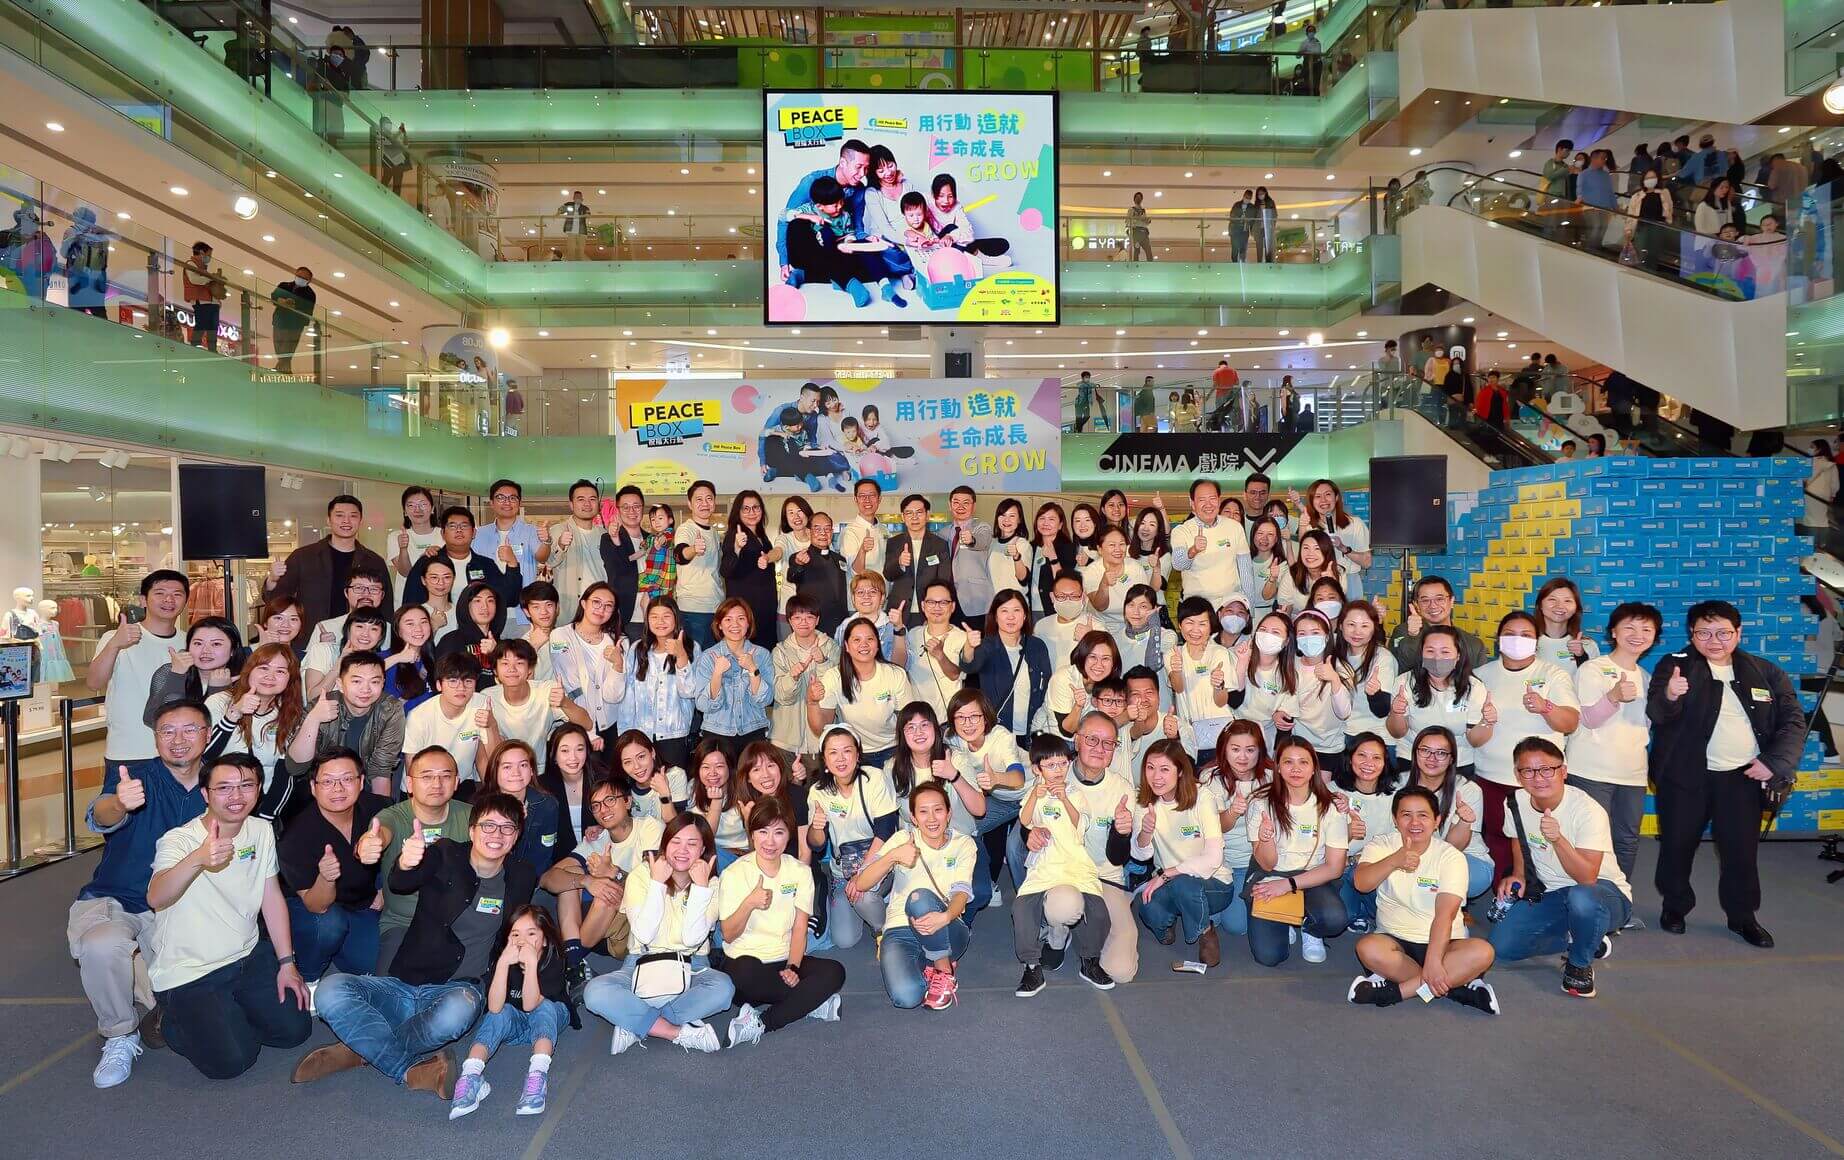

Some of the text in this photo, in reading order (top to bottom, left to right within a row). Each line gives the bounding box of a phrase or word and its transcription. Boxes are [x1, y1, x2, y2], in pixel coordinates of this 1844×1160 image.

[791, 108, 845, 125] PEACE
[919, 112, 972, 132] 用行動
[977, 112, 1020, 135] 造就
[792, 125, 827, 140] BOX
[934, 139, 1005, 158] 生命成長
[967, 160, 1040, 183] GROW
[644, 402, 705, 421] PEACE
[896, 392, 1017, 422] 用行動 造就
[646, 421, 684, 438] BOX
[939, 423, 1029, 450] 生命成長
[960, 448, 1048, 476] GROW
[1096, 452, 1240, 474] CINEMA 戲院
